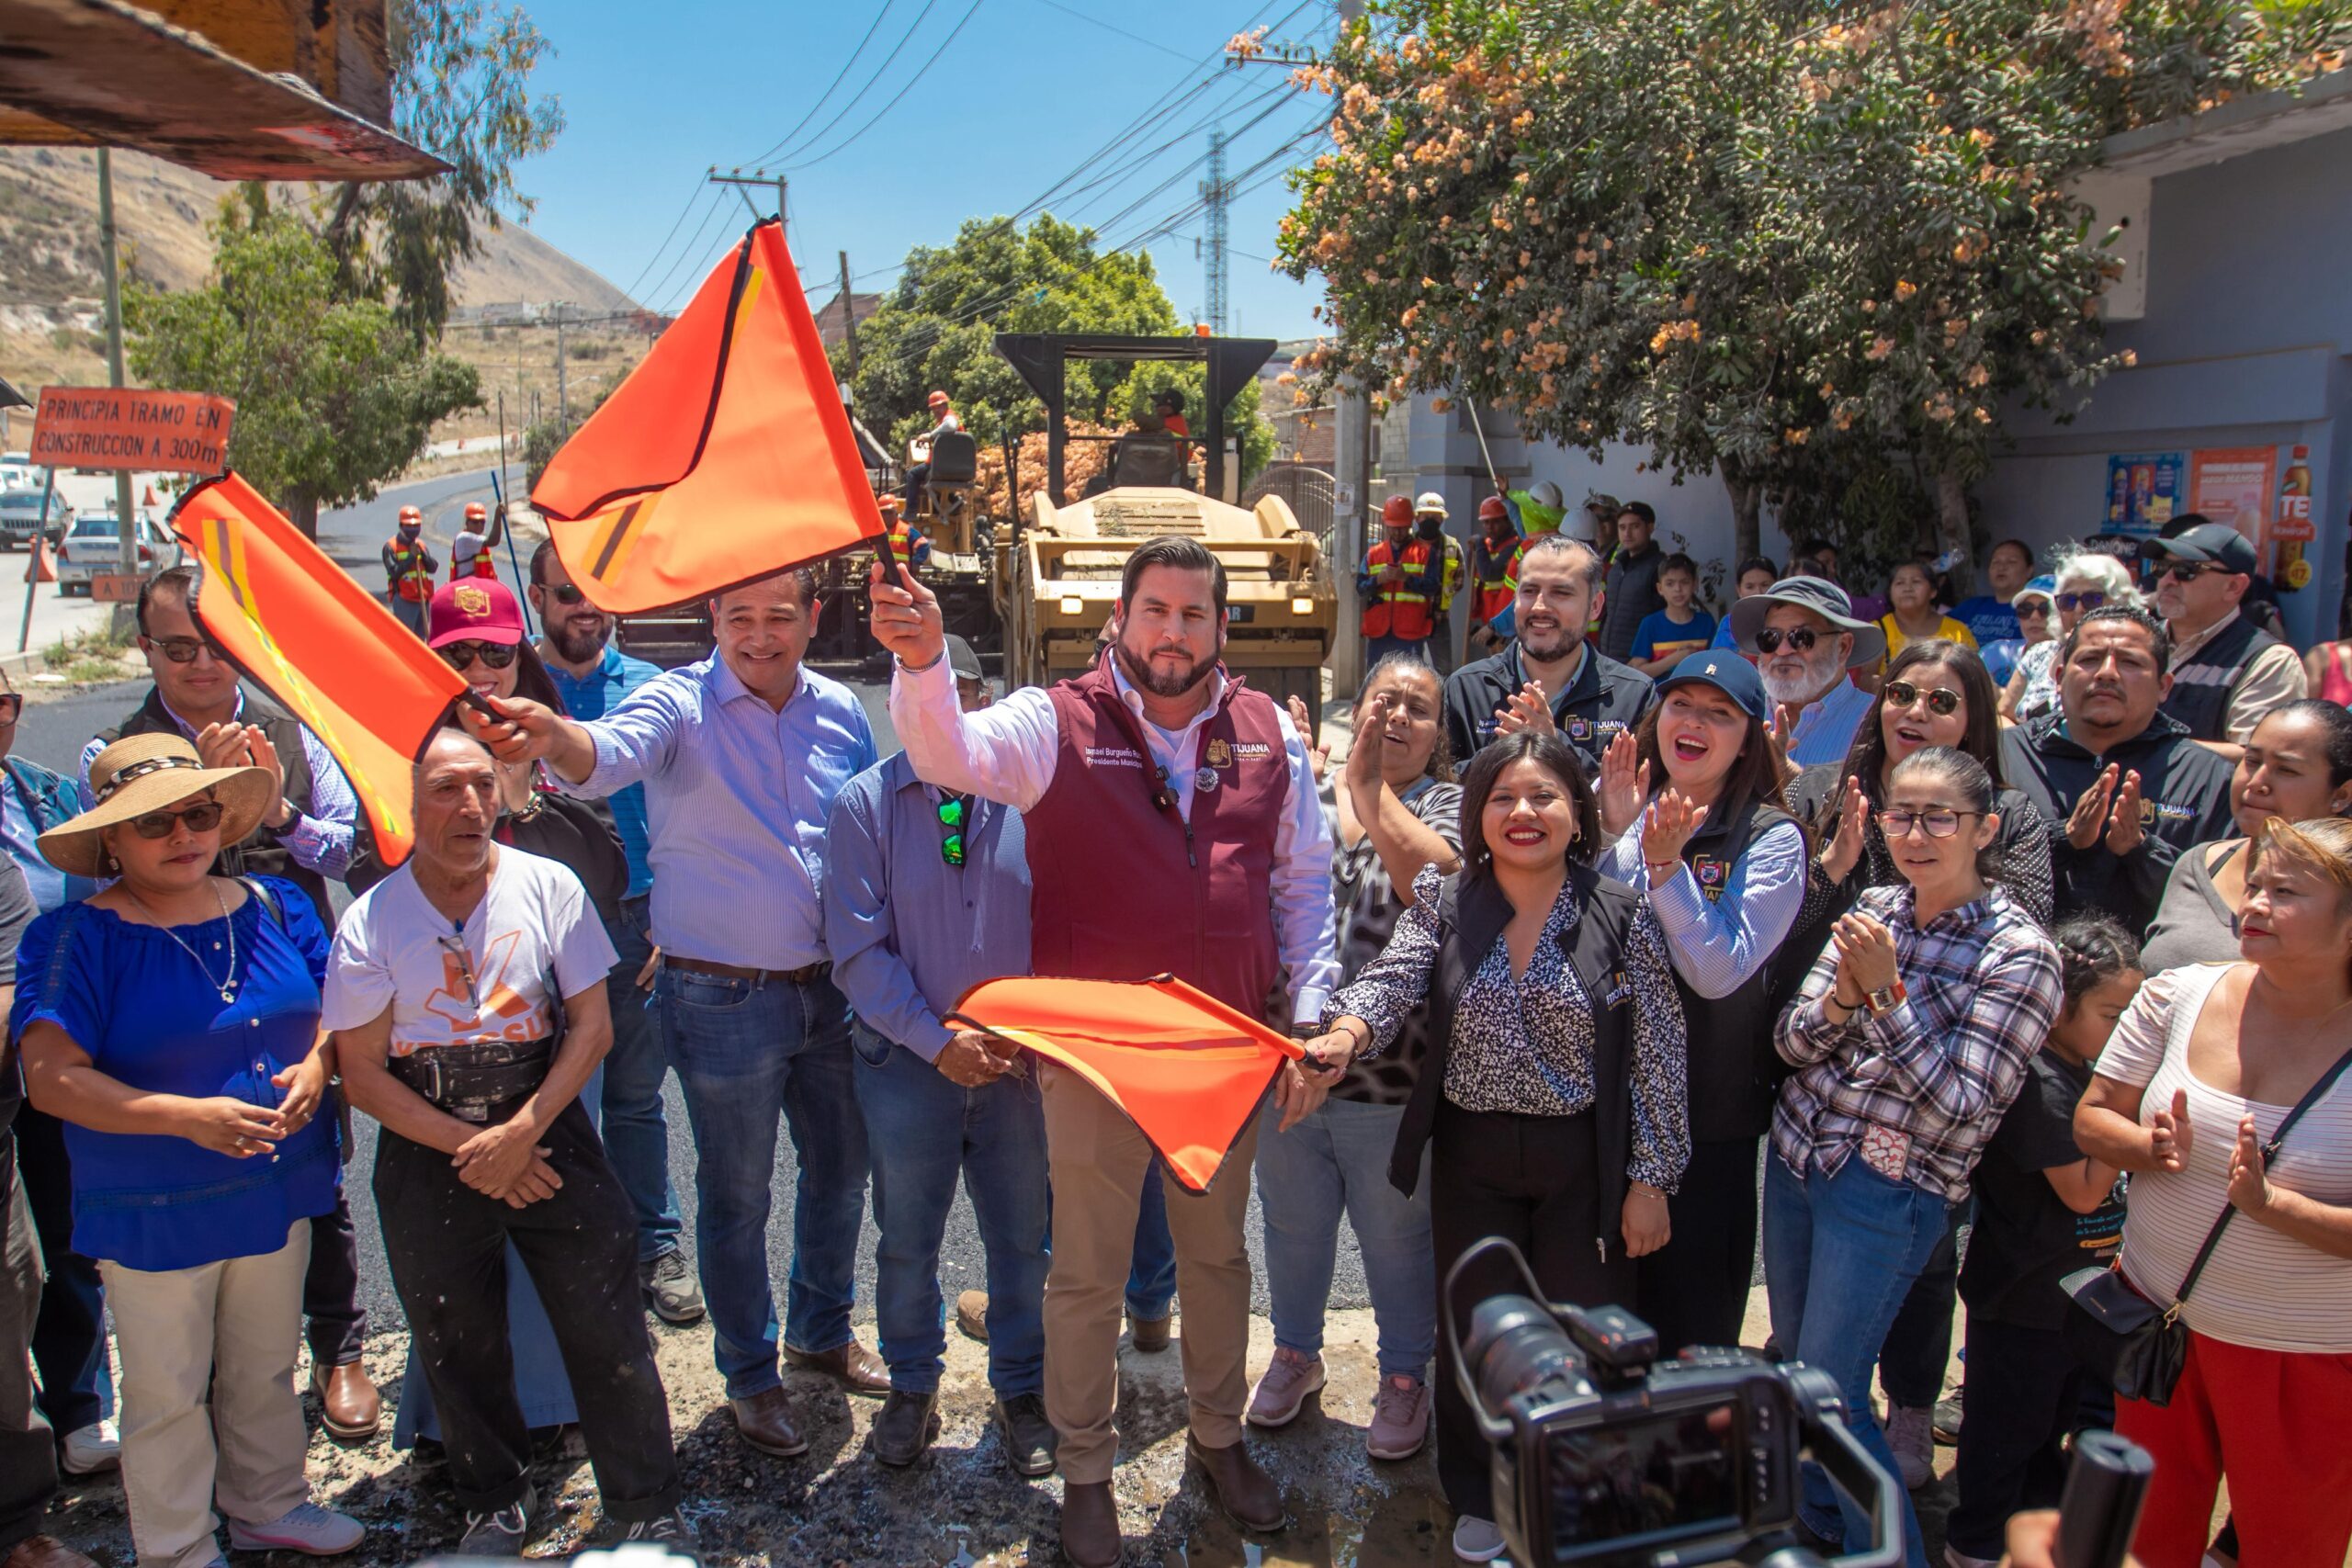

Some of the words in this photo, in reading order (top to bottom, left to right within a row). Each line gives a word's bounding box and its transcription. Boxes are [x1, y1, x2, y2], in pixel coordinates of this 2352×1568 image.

[47, 398, 119, 422] PRINCIPIA
[130, 400, 185, 426] TRAMO
[196, 407, 220, 430] EN
[37, 432, 144, 457] CONSTRUCCION
[151, 440, 161, 457] A
[1231, 743, 1271, 753] TIJUANA
[1086, 756, 1120, 765] Presidente
